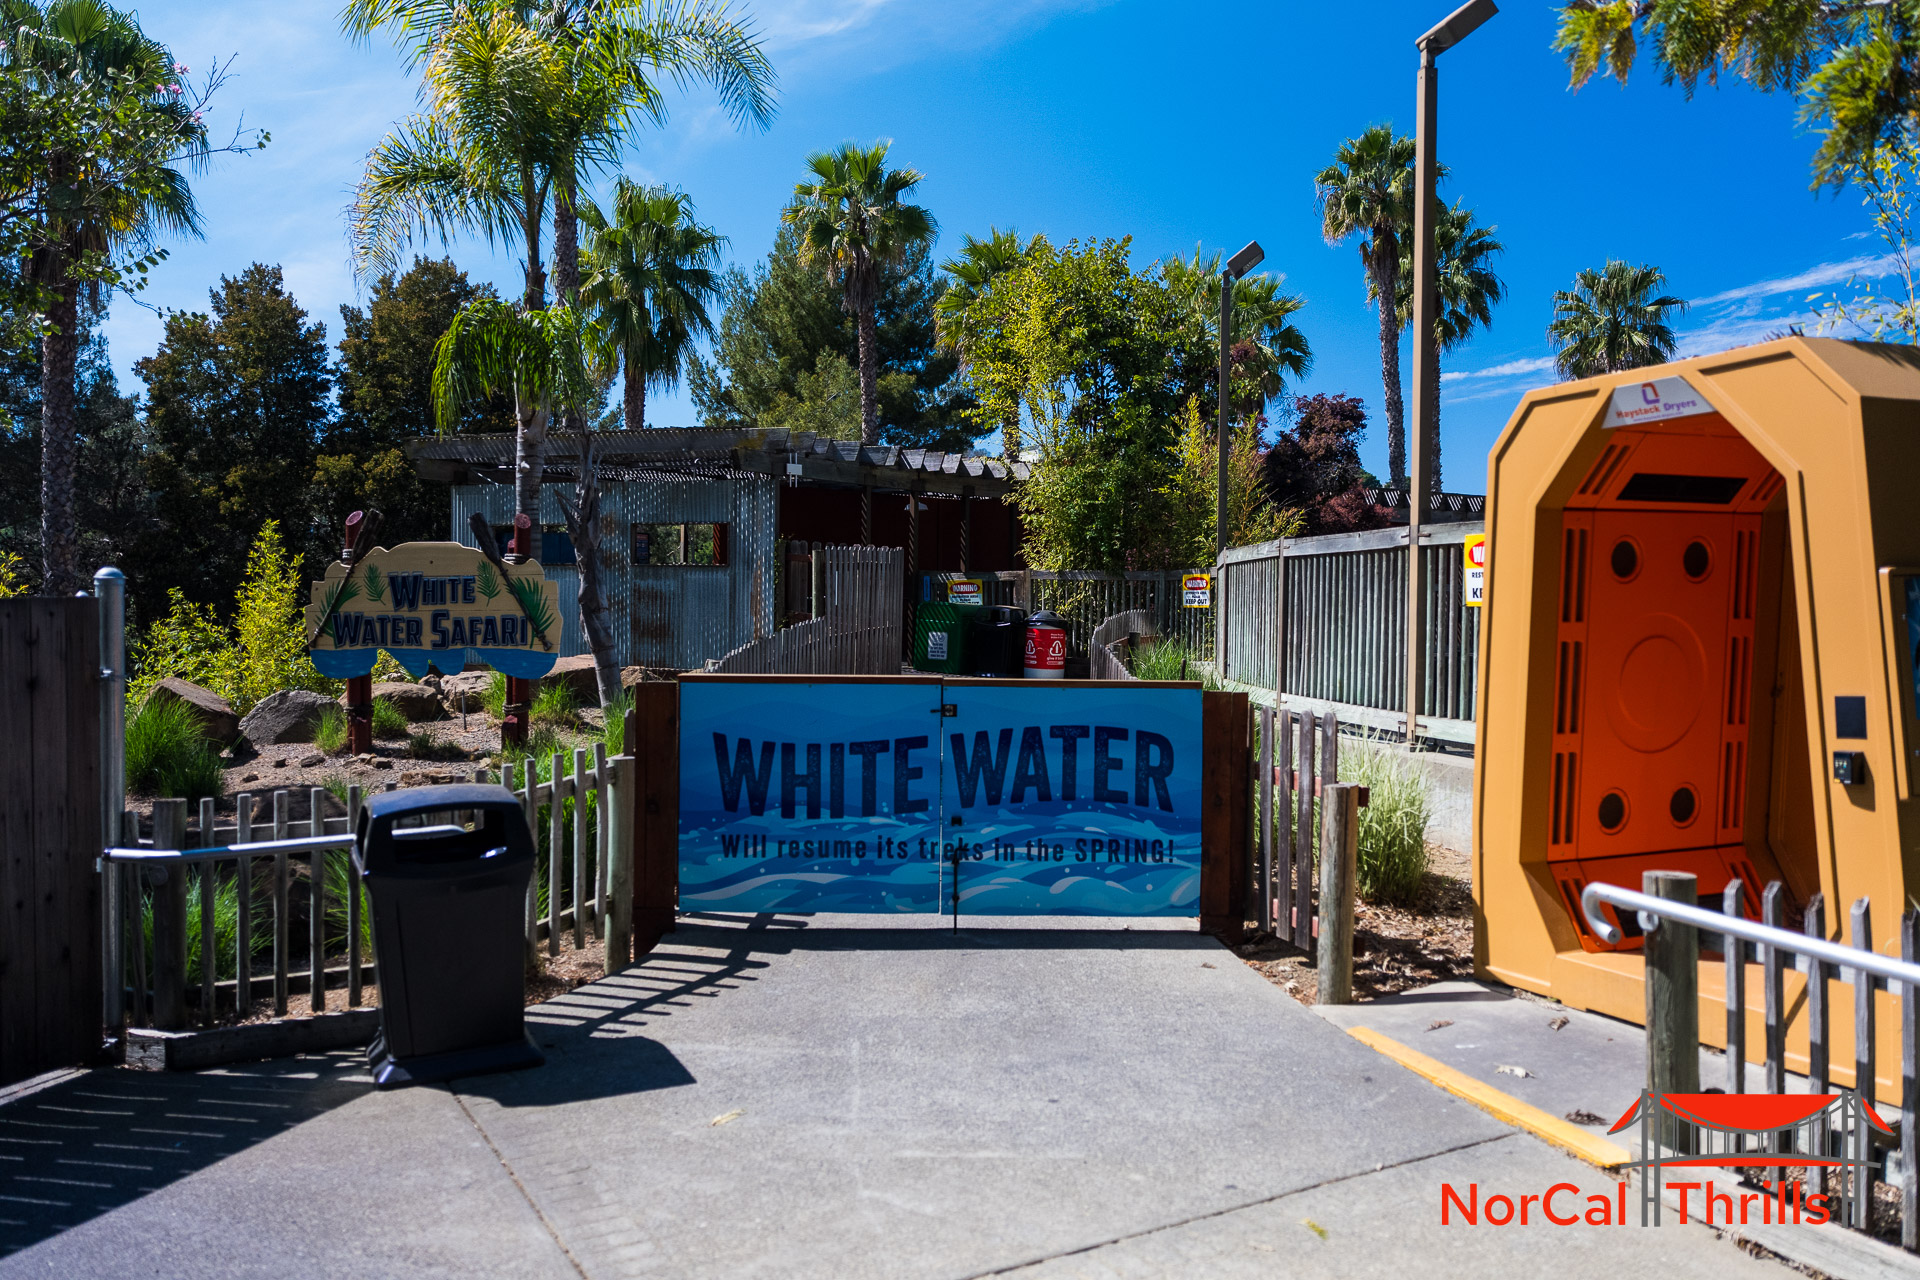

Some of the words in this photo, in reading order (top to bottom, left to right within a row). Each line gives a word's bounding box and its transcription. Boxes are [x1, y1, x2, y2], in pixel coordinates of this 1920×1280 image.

[1616, 405, 1661, 419] Haystack
[1663, 399, 1697, 412] Dryers
[388, 571, 476, 612] WHITE
[952, 584, 978, 592] WARNING
[332, 611, 423, 649] WATER
[430, 609, 528, 649] SAFARI
[712, 731, 928, 820] WHITE
[950, 725, 1174, 813] WATER
[721, 834, 767, 859] Will
[777, 838, 867, 860] resume
[877, 834, 909, 860] its
[918, 837, 984, 862] treks
[994, 837, 1015, 862] in
[1026, 838, 1064, 862] the
[1075, 838, 1174, 864] SPRING!
